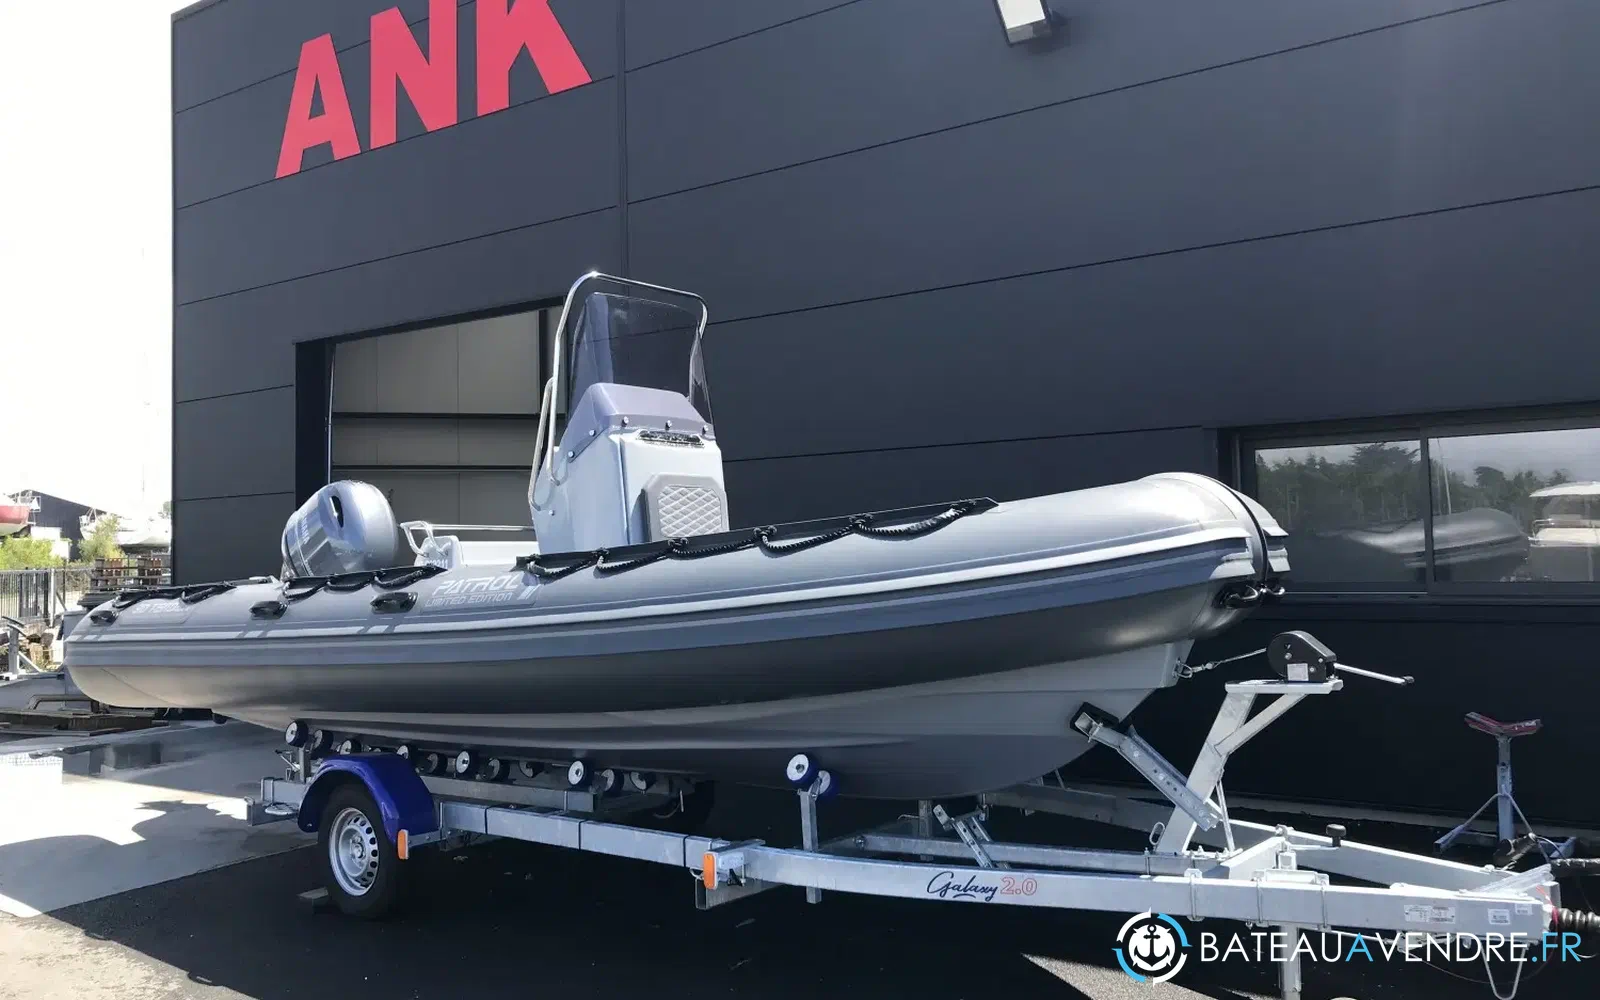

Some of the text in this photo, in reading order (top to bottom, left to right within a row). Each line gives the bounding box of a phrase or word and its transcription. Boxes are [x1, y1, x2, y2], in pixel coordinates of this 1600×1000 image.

[275, 0, 593, 179] ANK
[432, 574, 520, 596] PATROL
[425, 592, 513, 607] LIMITED EDITION
[927, 871, 1038, 902] Galaxy 2.0
